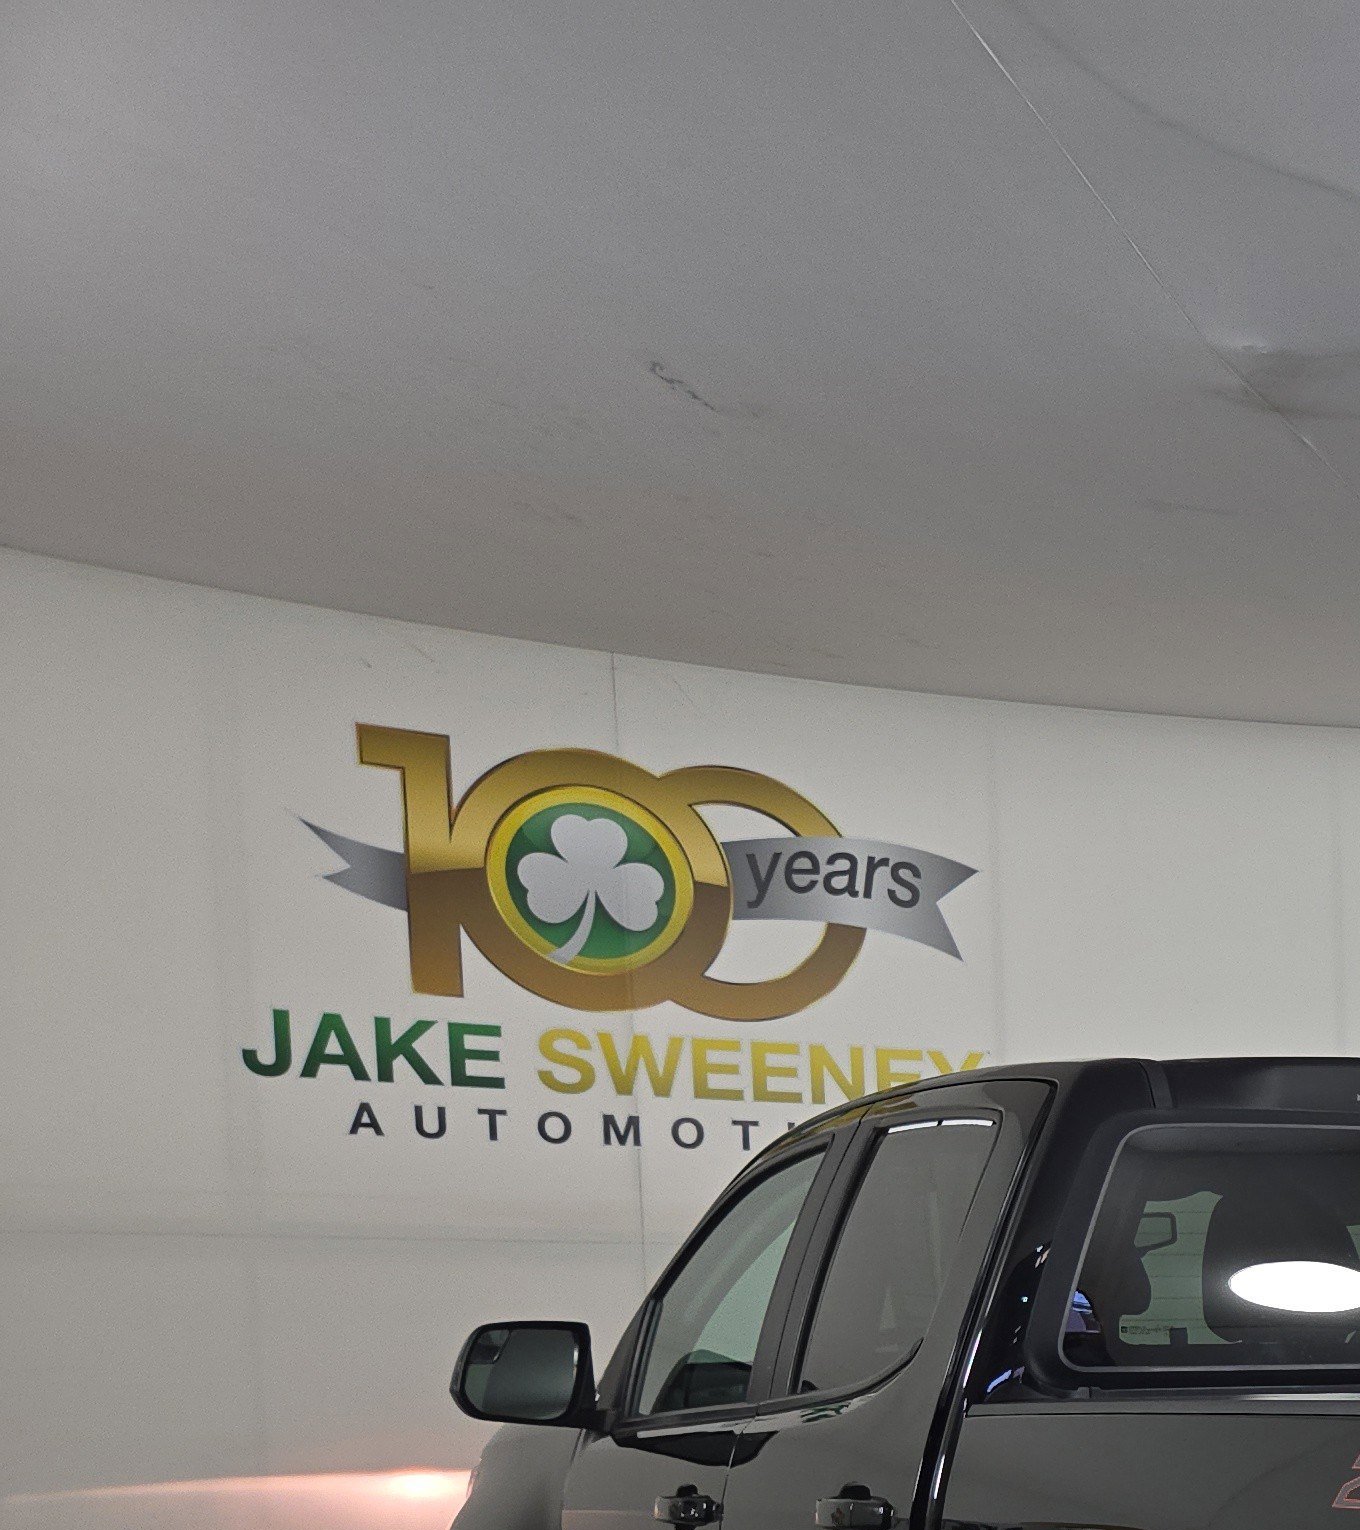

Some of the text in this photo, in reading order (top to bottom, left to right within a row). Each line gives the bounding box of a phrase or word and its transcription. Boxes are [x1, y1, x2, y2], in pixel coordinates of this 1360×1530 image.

[355, 722, 867, 1021] 100
[746, 850, 923, 909] years
[242, 1009, 506, 1089] JAKE
